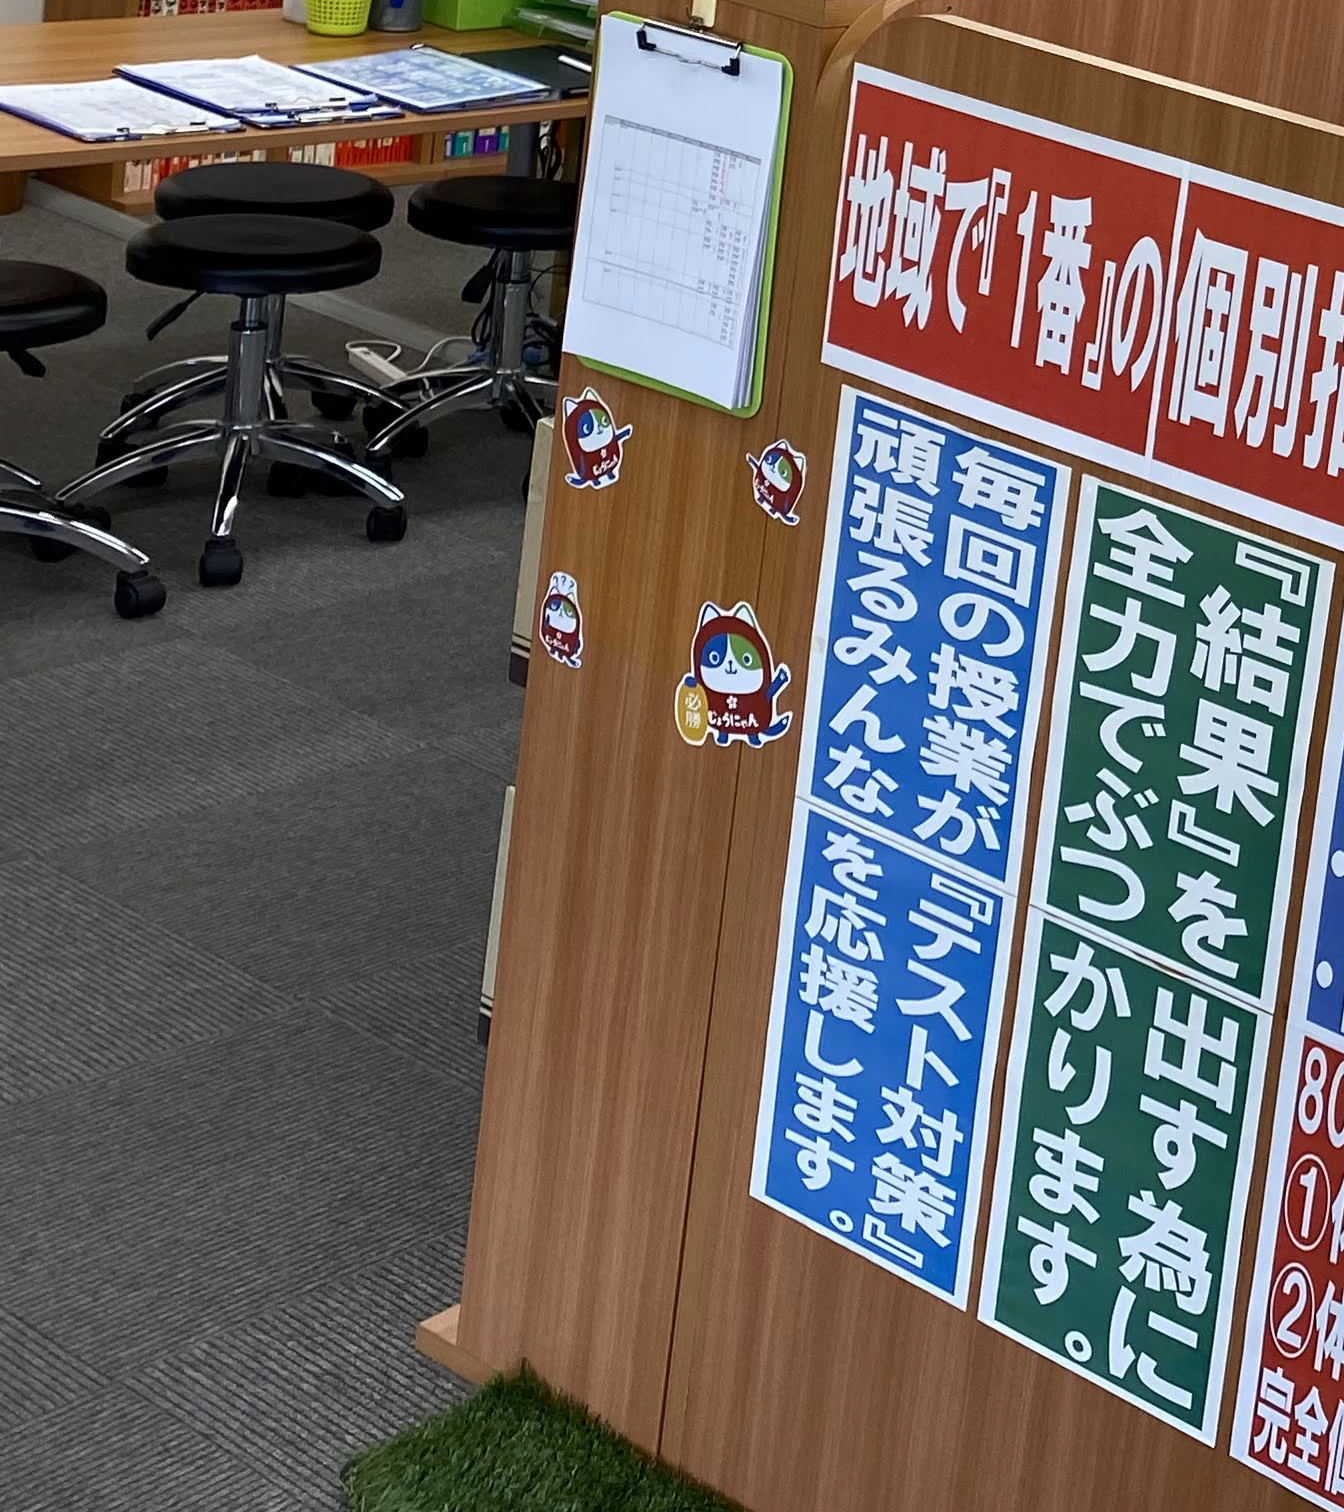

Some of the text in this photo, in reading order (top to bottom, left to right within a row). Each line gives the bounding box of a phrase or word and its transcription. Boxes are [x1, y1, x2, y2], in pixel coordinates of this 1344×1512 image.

[684, 692, 703, 730] 必勝
[707, 709, 759, 730] じょうにゃん
[784, 405, 947, 1232] 頑張るみんなを応援します。
[862, 444, 1047, 1274] 毎回の授業が『テスト対策』
[1016, 507, 1194, 1363] 全力でぶつかります。
[1109, 537, 1312, 1410] 『結果』を出す為に
